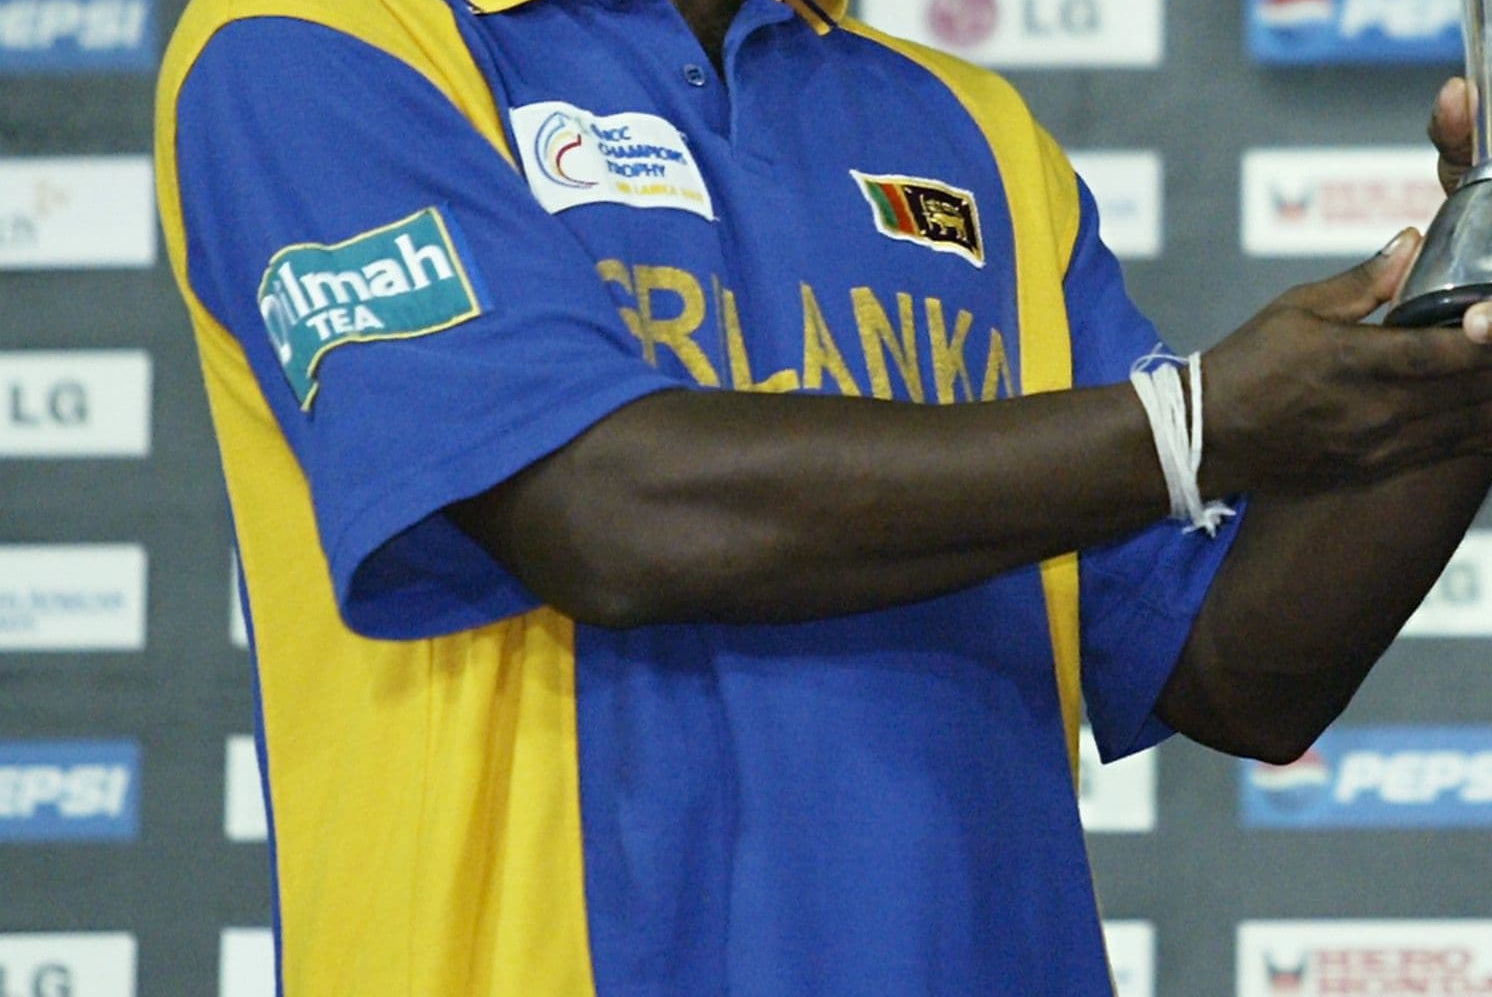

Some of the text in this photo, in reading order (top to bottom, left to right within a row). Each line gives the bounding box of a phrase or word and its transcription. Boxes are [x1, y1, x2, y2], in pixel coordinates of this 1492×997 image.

[598, 142, 687, 166] CHAMPIONS
[605, 159, 666, 179] TROPHY
[305, 305, 384, 341] TEA
[9, 378, 88, 426] LG
[0, 764, 130, 819] EPSI
